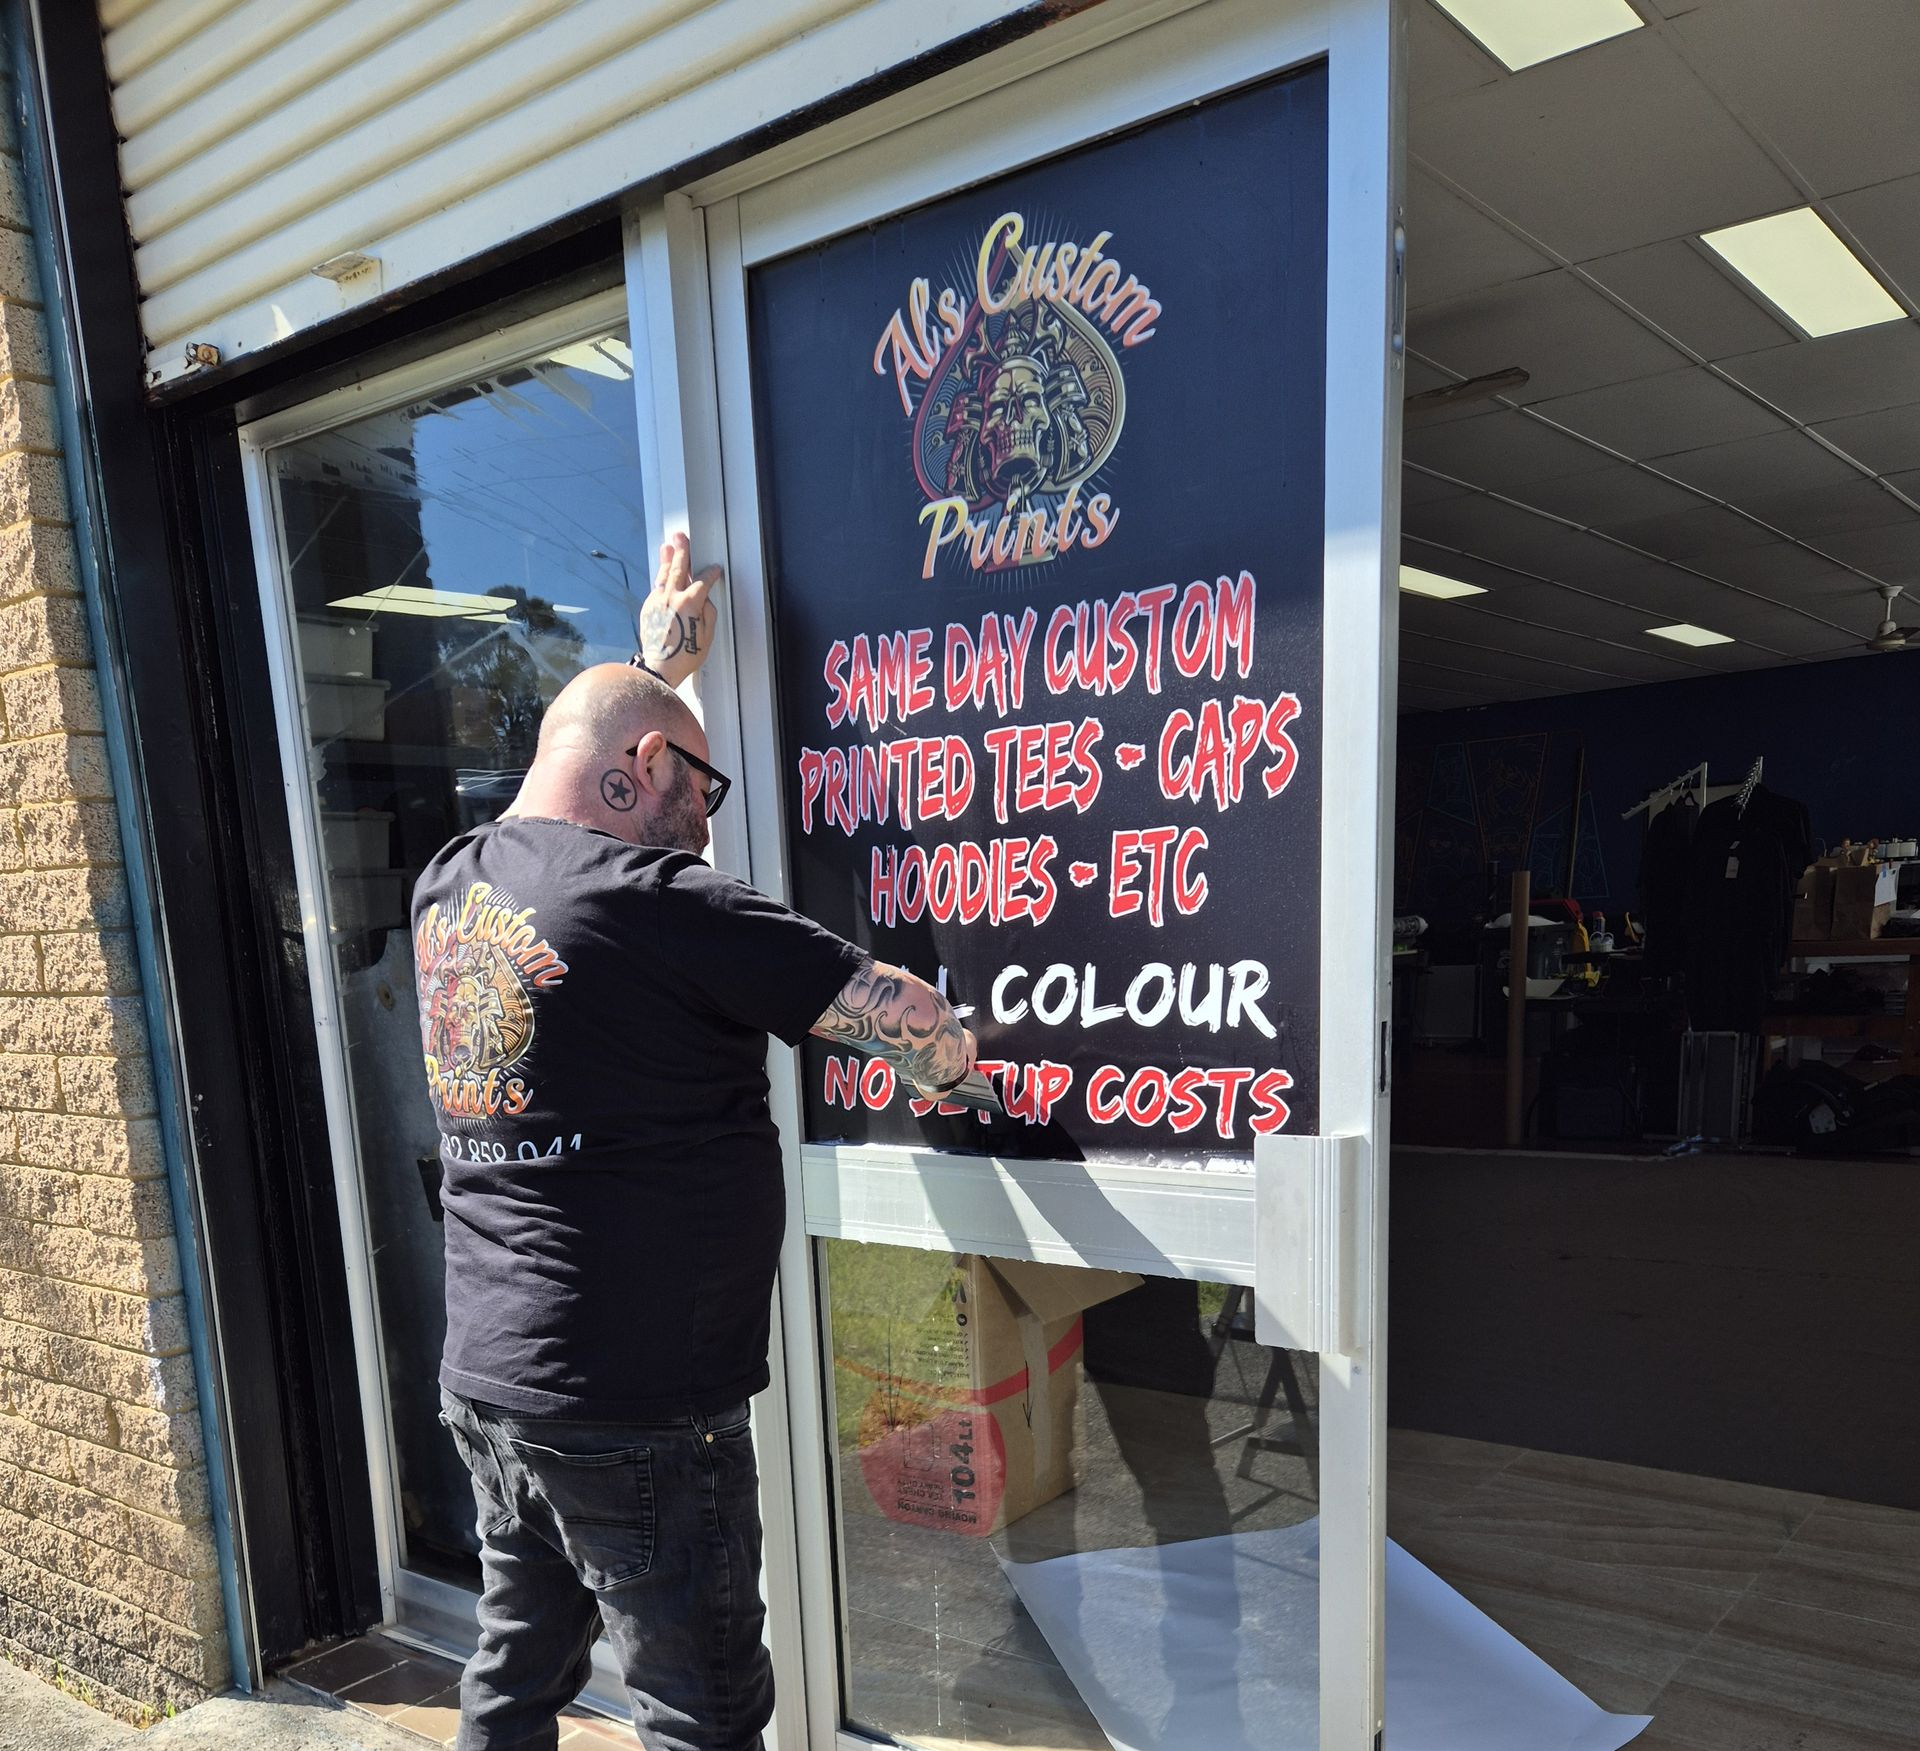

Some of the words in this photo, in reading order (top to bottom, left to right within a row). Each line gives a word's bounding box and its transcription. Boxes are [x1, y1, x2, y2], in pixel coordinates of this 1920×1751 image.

[873, 277, 965, 418] Als
[977, 211, 1162, 347] Custom
[918, 483, 1121, 579] Prints
[824, 629, 934, 731] SAME
[943, 608, 1038, 716] DAY
[1044, 571, 1256, 695] CUSTOM
[799, 734, 975, 836] PRINTED
[983, 716, 1103, 825] TEES
[1157, 692, 1302, 812] CAPS
[869, 834, 1058, 928] HOODIES
[1109, 825, 1209, 926] ETC
[456, 882, 569, 988] Custom
[991, 961, 1278, 1038] COLOUR
[424, 1054, 534, 1115] Prints
[825, 1055, 896, 1110] NO
[1085, 1064, 1295, 1138] COSTS
